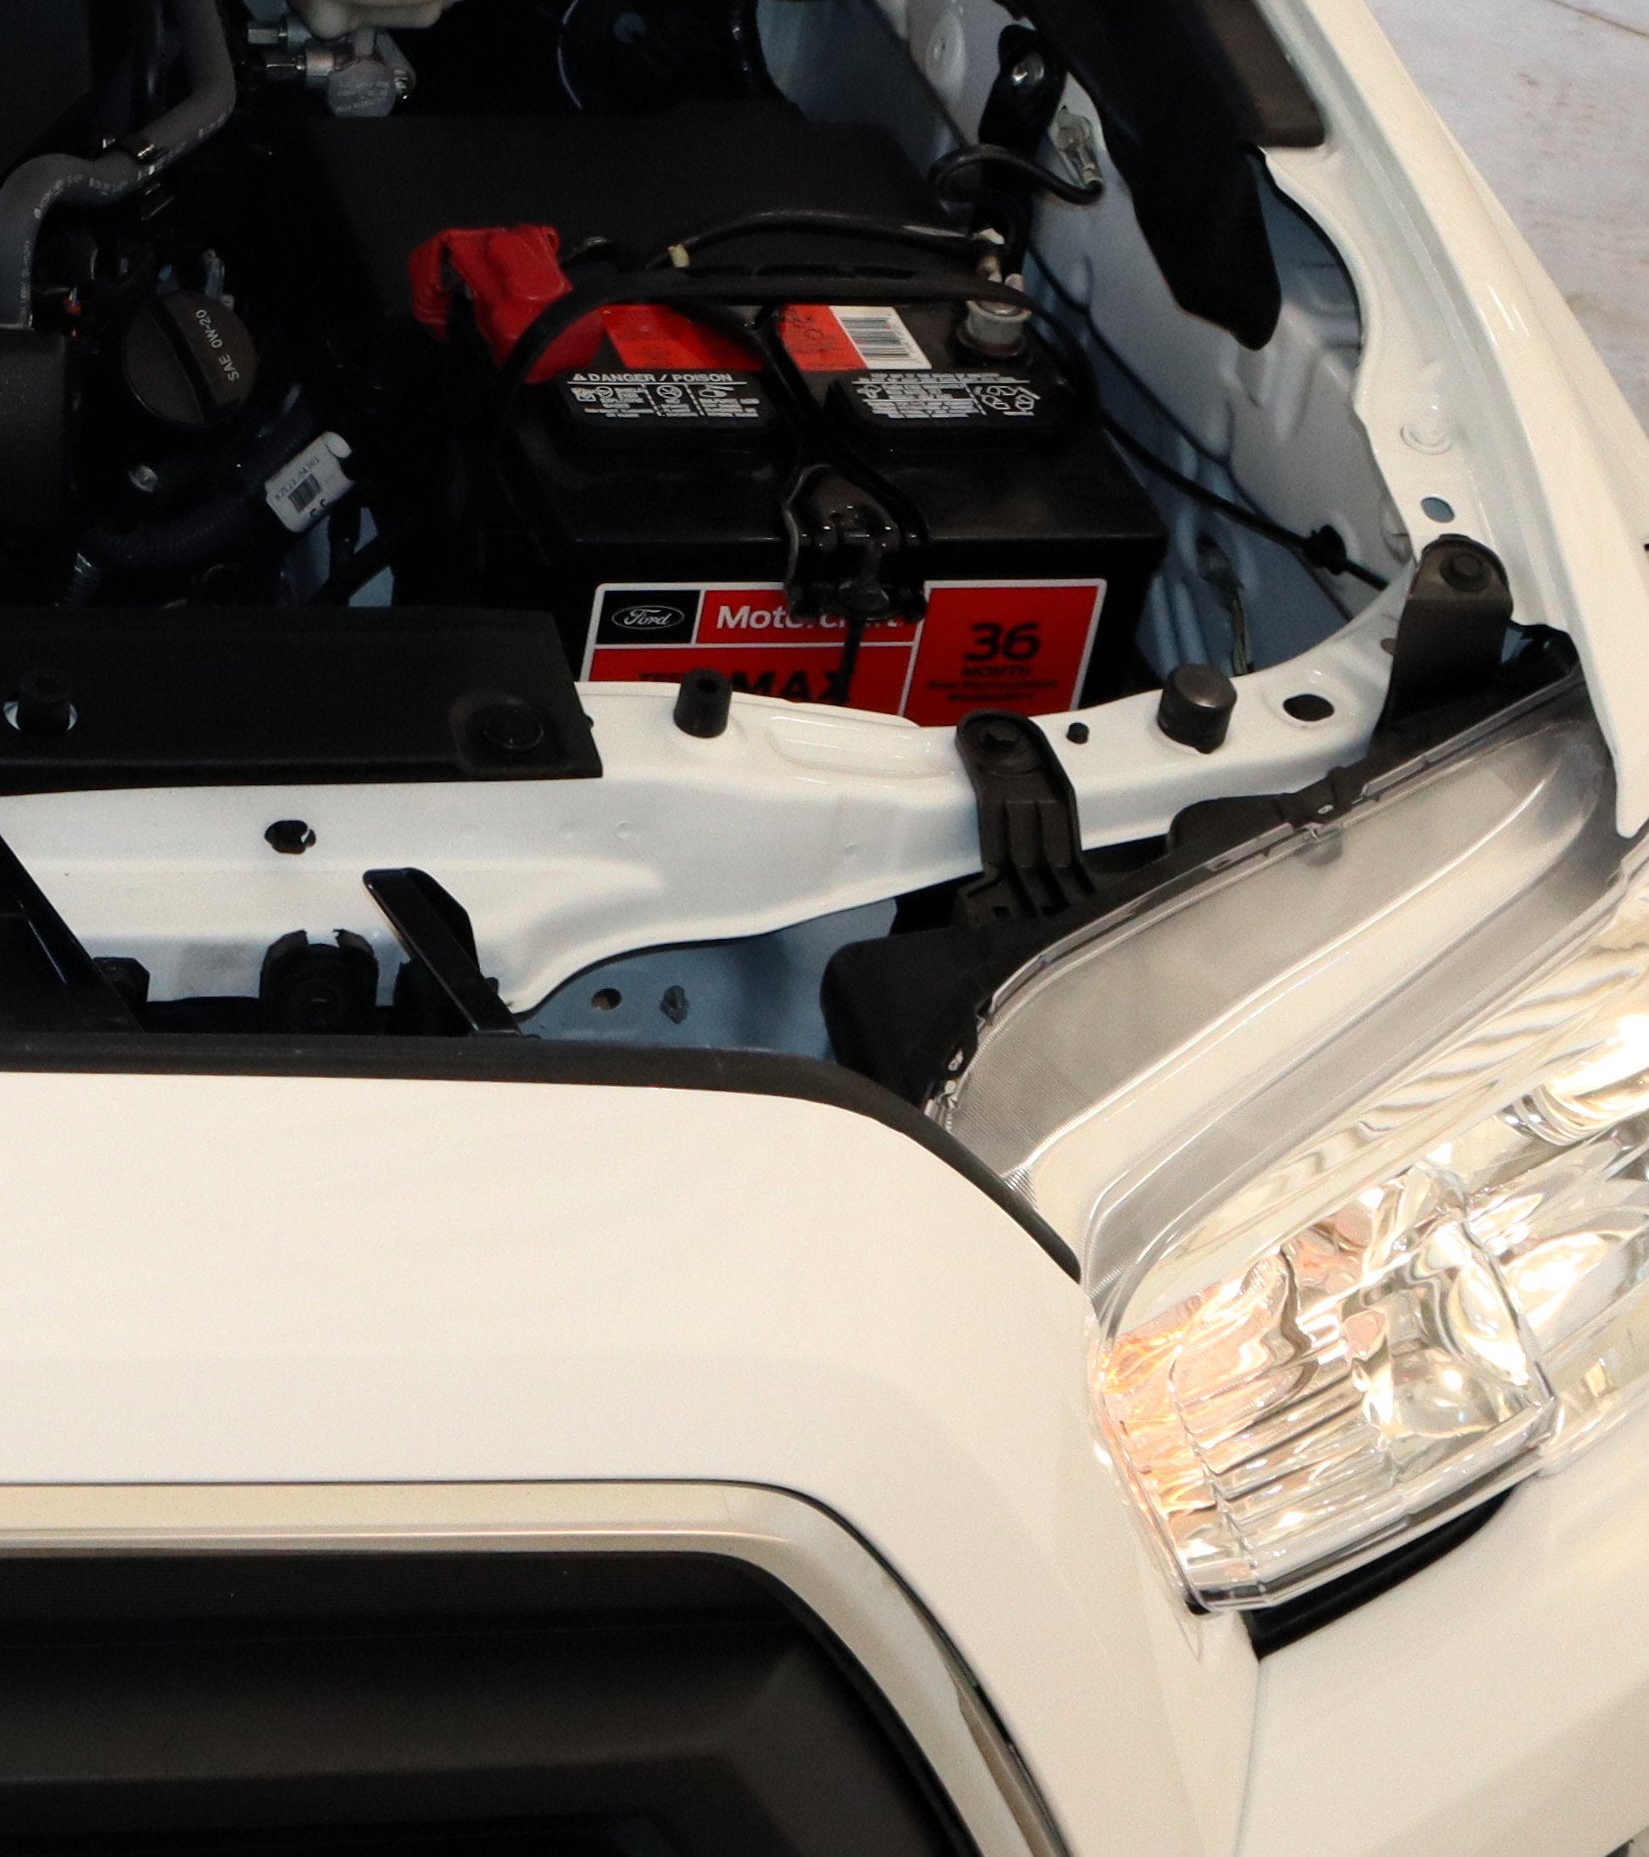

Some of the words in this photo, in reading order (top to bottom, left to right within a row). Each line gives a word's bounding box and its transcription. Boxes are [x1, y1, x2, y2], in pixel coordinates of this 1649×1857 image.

[218, 354, 241, 382] SAE
[586, 373, 656, 382] DANGER
[670, 373, 734, 382] POISON
[622, 608, 672, 627] Ford
[963, 621, 1042, 661] 36
[961, 665, 1031, 677] MONTH
